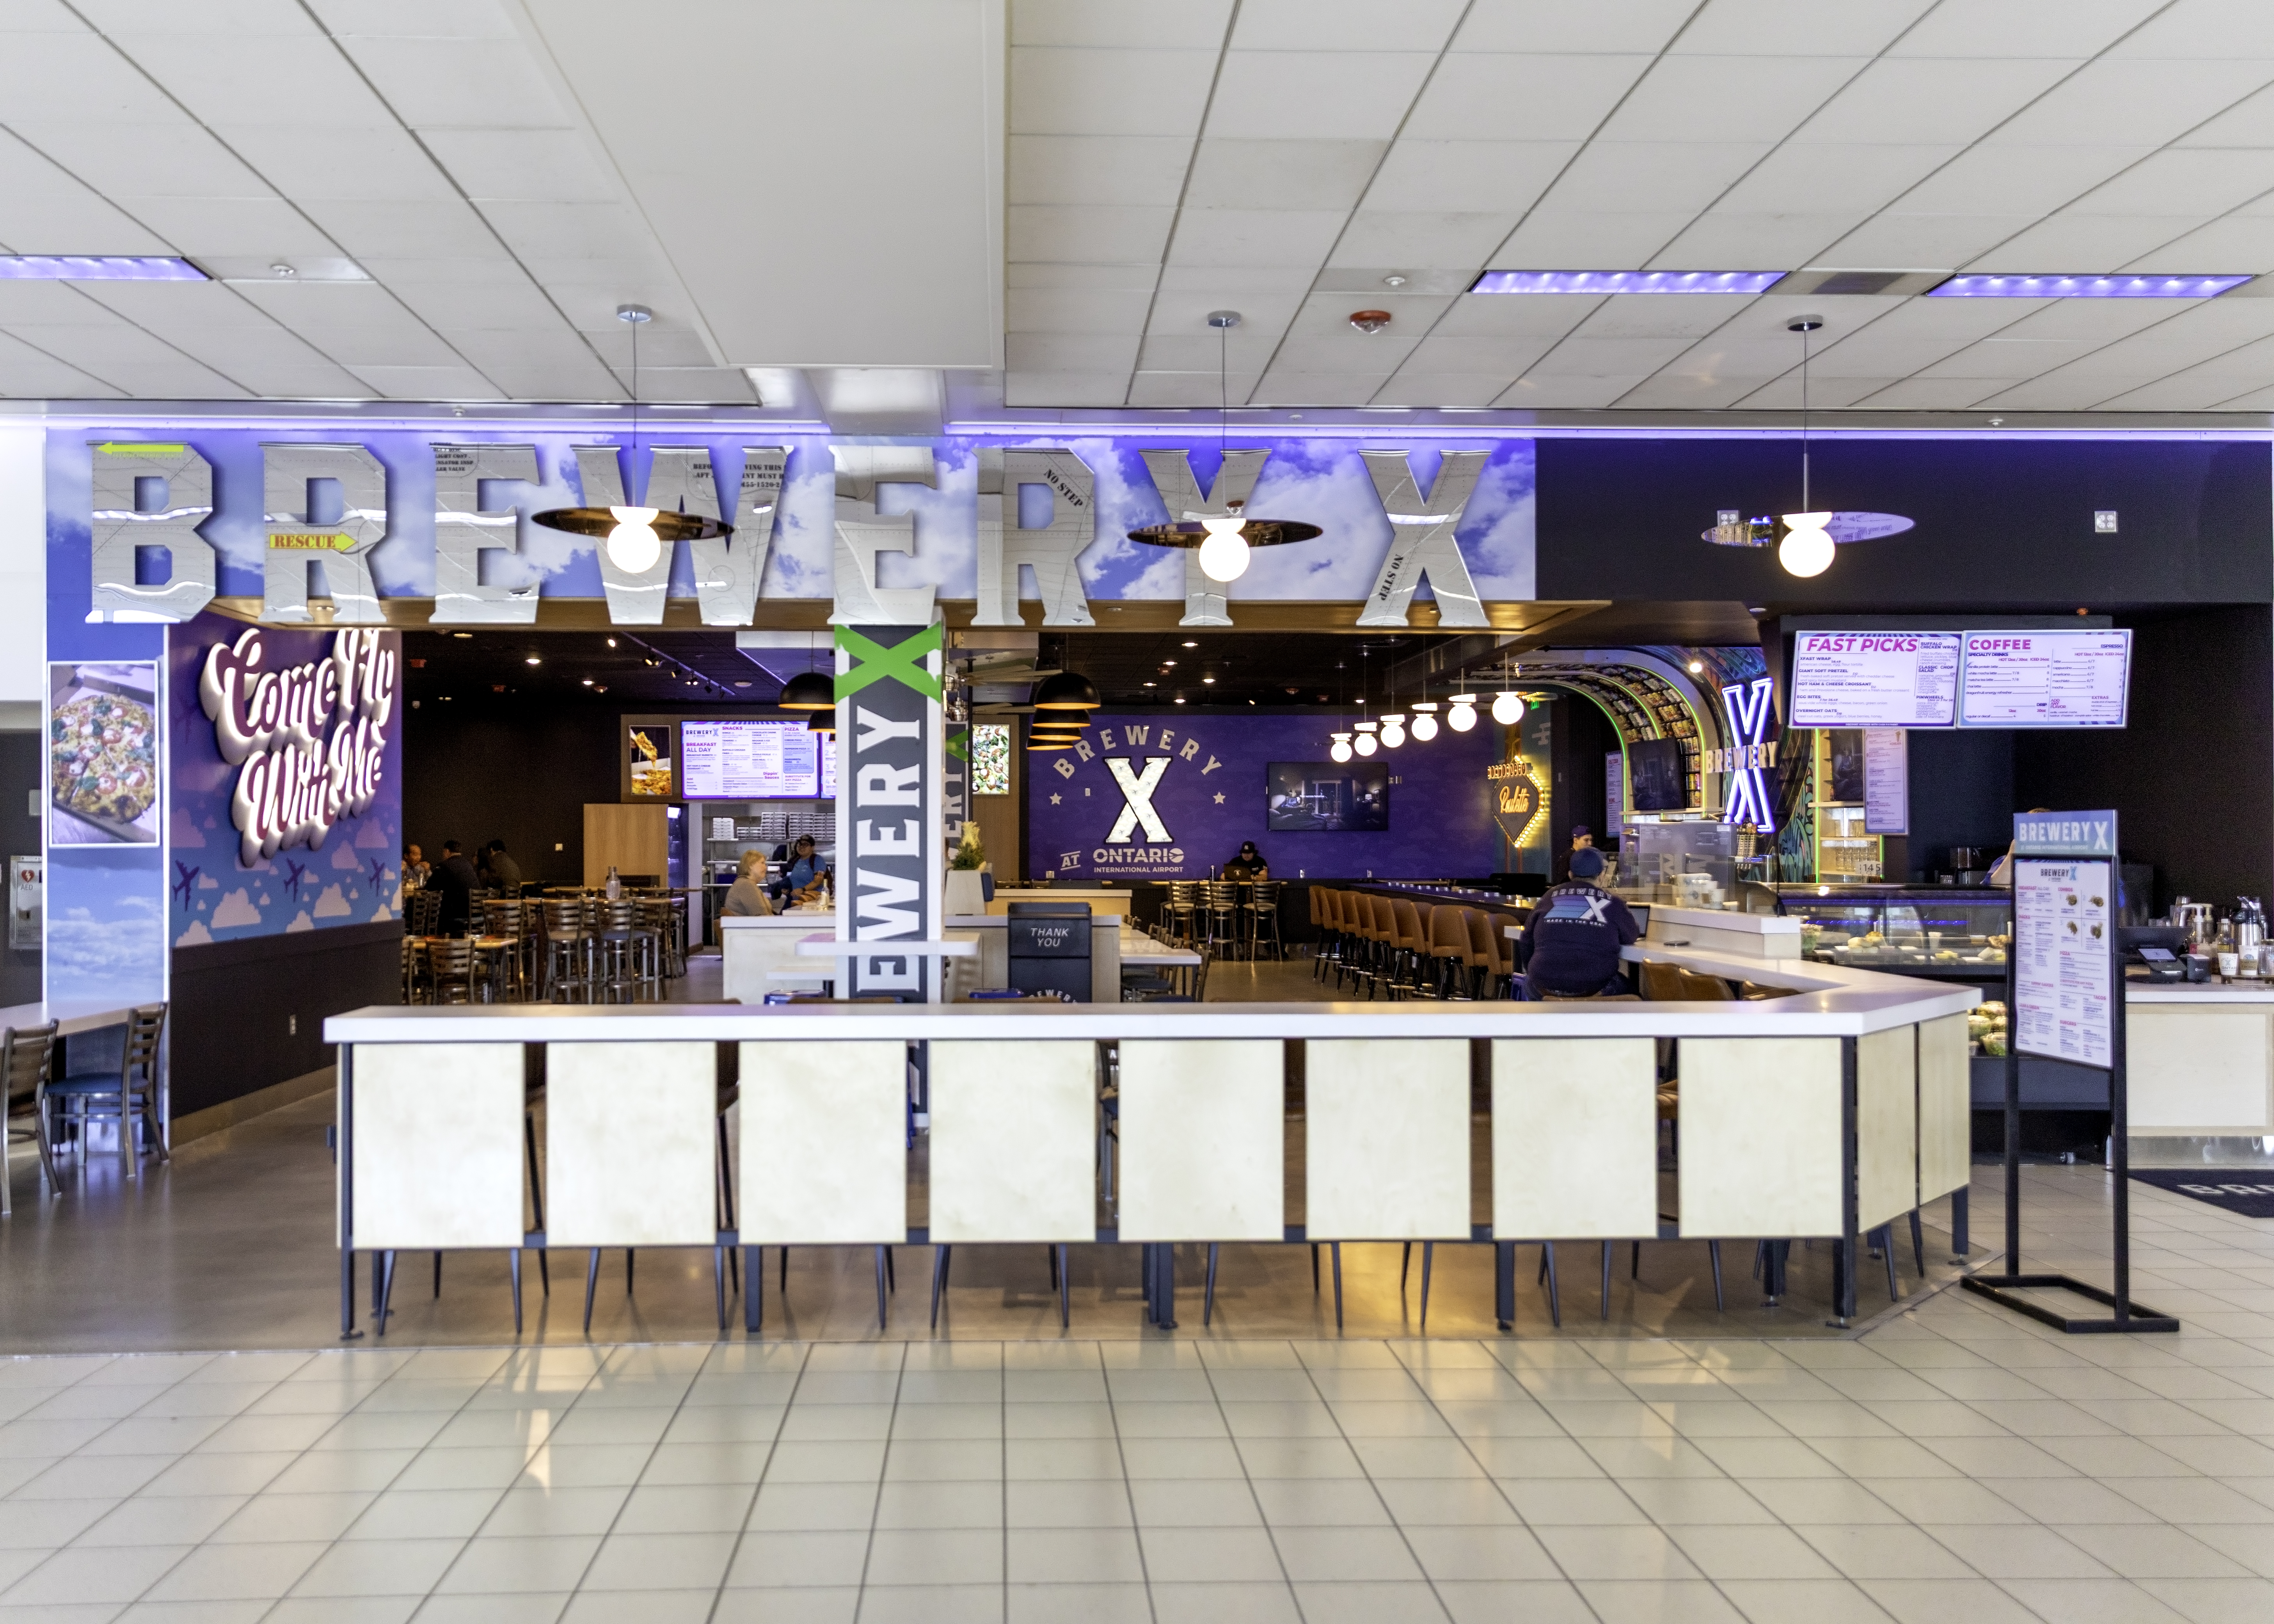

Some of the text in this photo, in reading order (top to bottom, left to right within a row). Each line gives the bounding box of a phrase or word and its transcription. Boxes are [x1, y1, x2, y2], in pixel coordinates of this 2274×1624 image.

[1044, 469, 1083, 506] NO STEP
[85, 440, 1491, 626] BREWERY X
[275, 536, 336, 548] RESCUE
[1379, 554, 1403, 600] NO STEP
[1807, 638, 1918, 651] FAST PICKS
[1969, 639, 2031, 650] COFFEE
[834, 621, 942, 703] X
[201, 627, 395, 753] Come Fly
[712, 728, 720, 737] X
[1053, 725, 1222, 779] BREWERY
[1706, 741, 1777, 774] BREWERY
[1721, 676, 1776, 834] X
[234, 716, 382, 854] With Me
[1499, 785, 1530, 813] Roulette
[1103, 756, 1174, 844] X
[2019, 821, 2108, 850] BREWERY X
[1061, 848, 1184, 868] AT ONTARIO
[2041, 866, 2077, 881] BREWERY X
[1551, 888, 1611, 900] BREWERY
[1579, 895, 1611, 923] X
[1031, 928, 1069, 937] THANK
[1038, 938, 1061, 947] YOU
